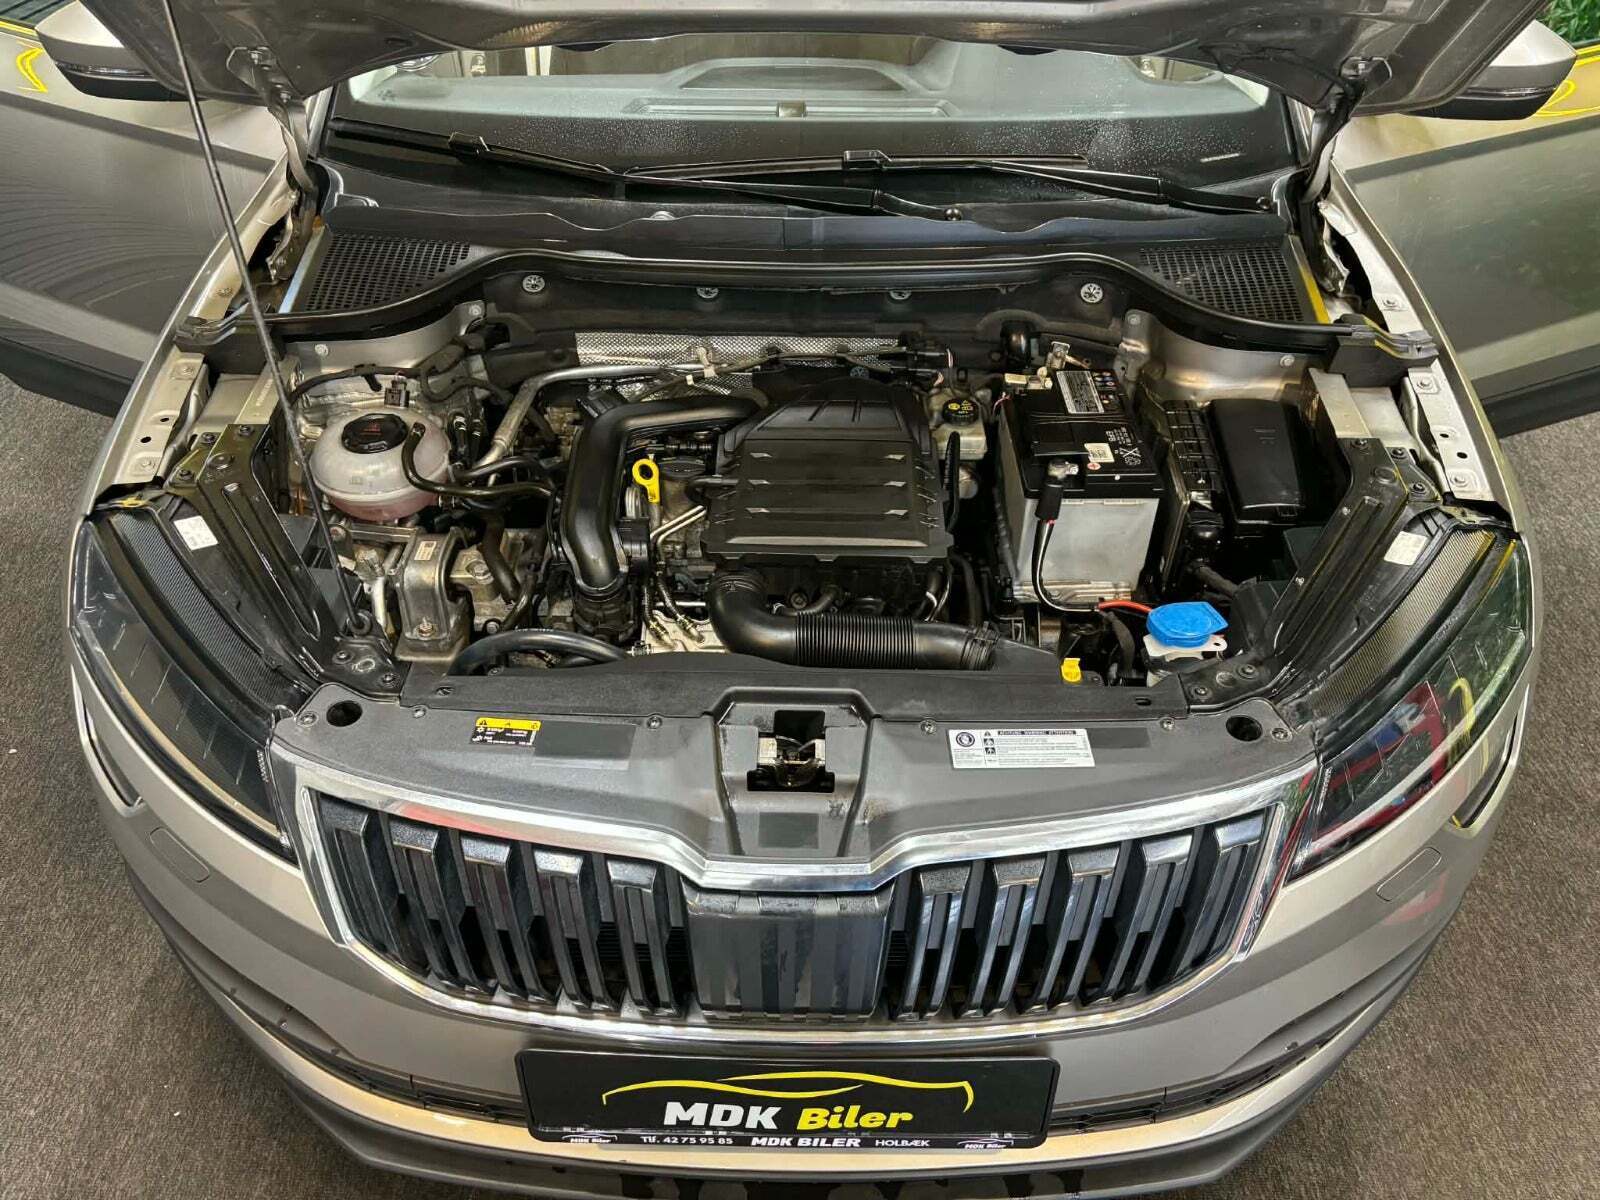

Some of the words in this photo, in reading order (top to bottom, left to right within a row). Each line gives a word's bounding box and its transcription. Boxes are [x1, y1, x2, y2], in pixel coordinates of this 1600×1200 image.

[664, 1102, 782, 1129] MDK
[797, 1104, 913, 1130] Biler
[663, 1136, 679, 1144] 42
[751, 1137, 793, 1147] MDK
[797, 1138, 861, 1147] BILER
[875, 1139, 930, 1147] HOLBÆK
